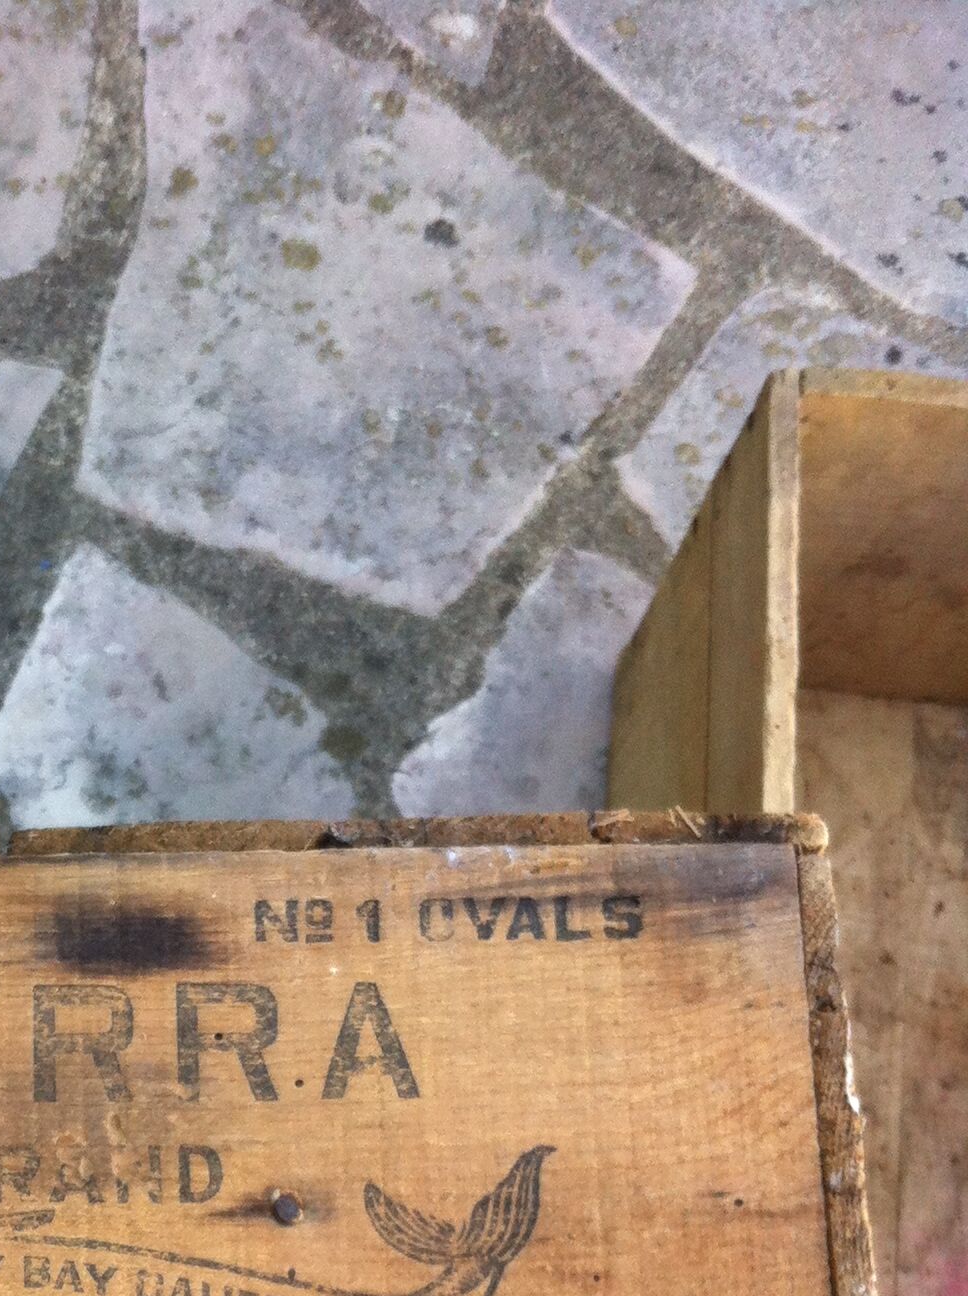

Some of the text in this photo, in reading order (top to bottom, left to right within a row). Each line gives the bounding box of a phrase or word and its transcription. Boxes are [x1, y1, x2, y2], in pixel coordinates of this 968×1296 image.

[356, 899, 380, 943] 1
[418, 896, 643, 942] OVALS
[23, 1256, 118, 1296] BAY
